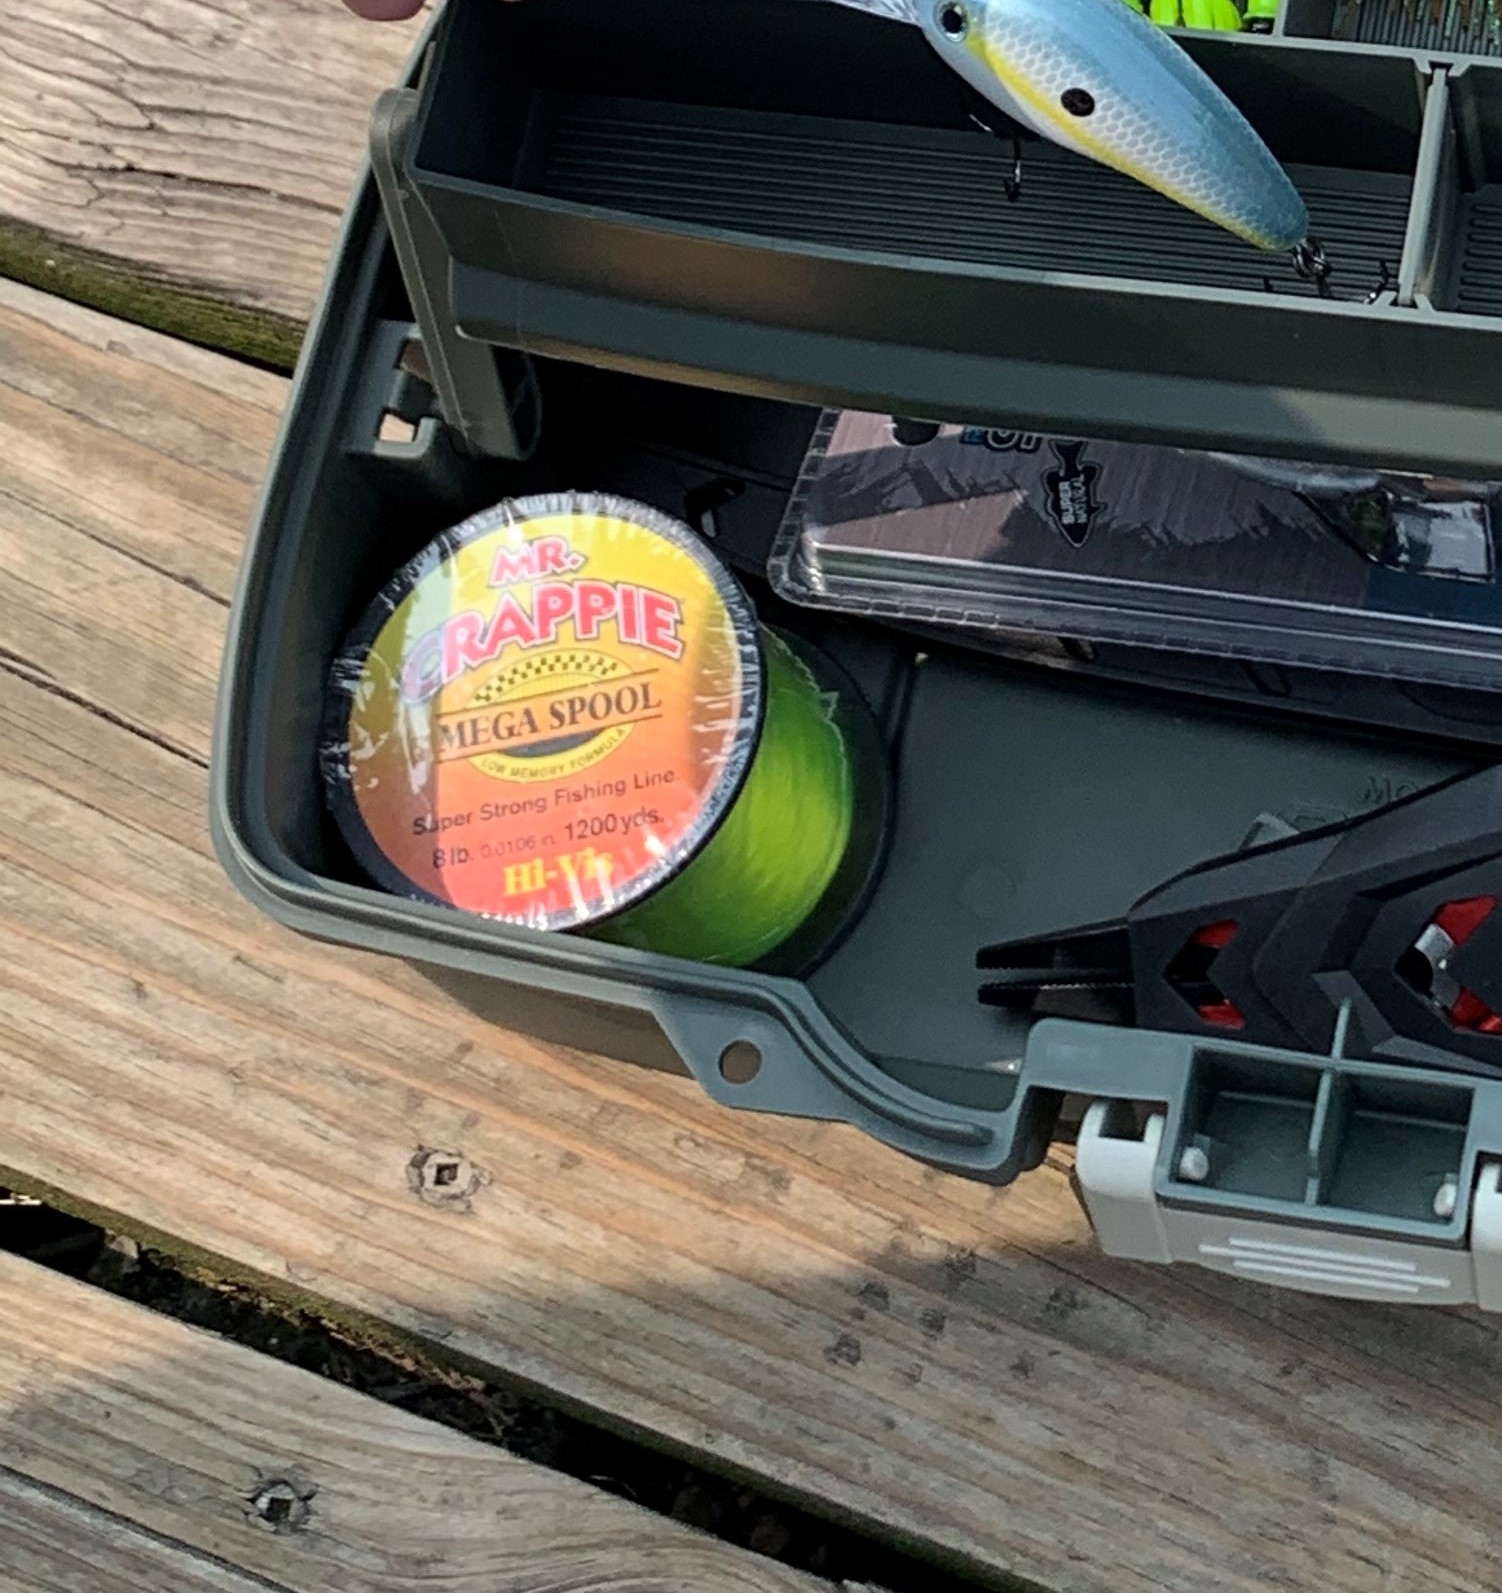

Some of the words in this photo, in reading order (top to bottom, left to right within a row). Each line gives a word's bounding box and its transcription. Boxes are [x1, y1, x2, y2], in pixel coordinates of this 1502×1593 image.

[488, 534, 588, 589] MR.
[401, 579, 686, 705] CRAPPIE
[438, 710, 540, 754] MEGA
[548, 680, 663, 732] SPOOL
[481, 758, 506, 776] LOW
[510, 764, 566, 779] MEMORY
[568, 726, 628, 771] FORMULA
[412, 811, 473, 837] Super
[479, 796, 548, 821] Strong
[554, 779, 627, 807] Fishing
[564, 813, 619, 841] 1200
[503, 847, 614, 896] Hi-Vis
